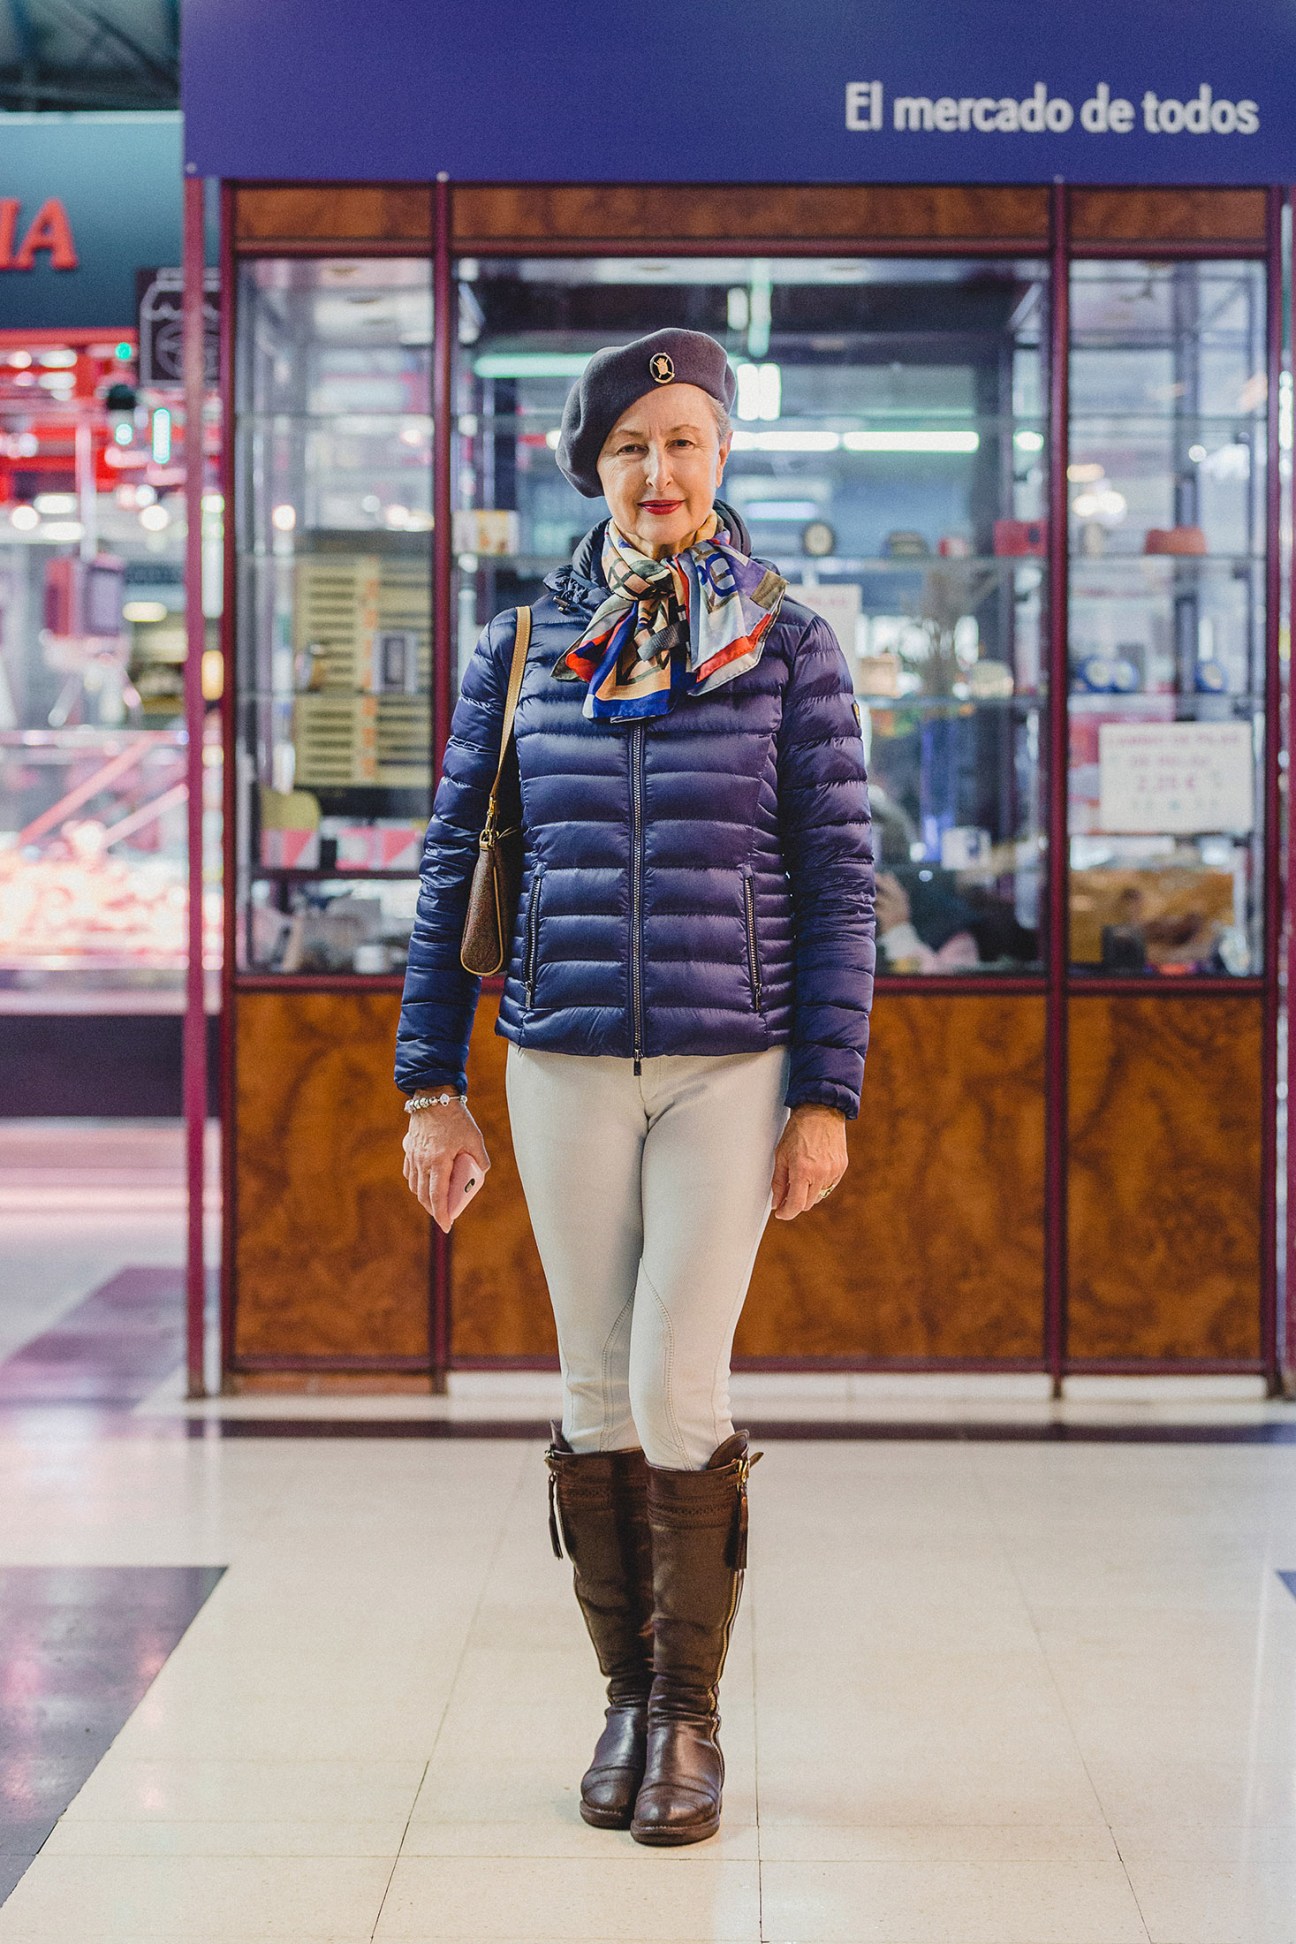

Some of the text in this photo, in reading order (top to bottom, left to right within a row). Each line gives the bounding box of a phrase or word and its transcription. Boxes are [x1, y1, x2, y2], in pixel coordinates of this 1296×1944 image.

[845, 80, 1260, 134] El mercado de todos
